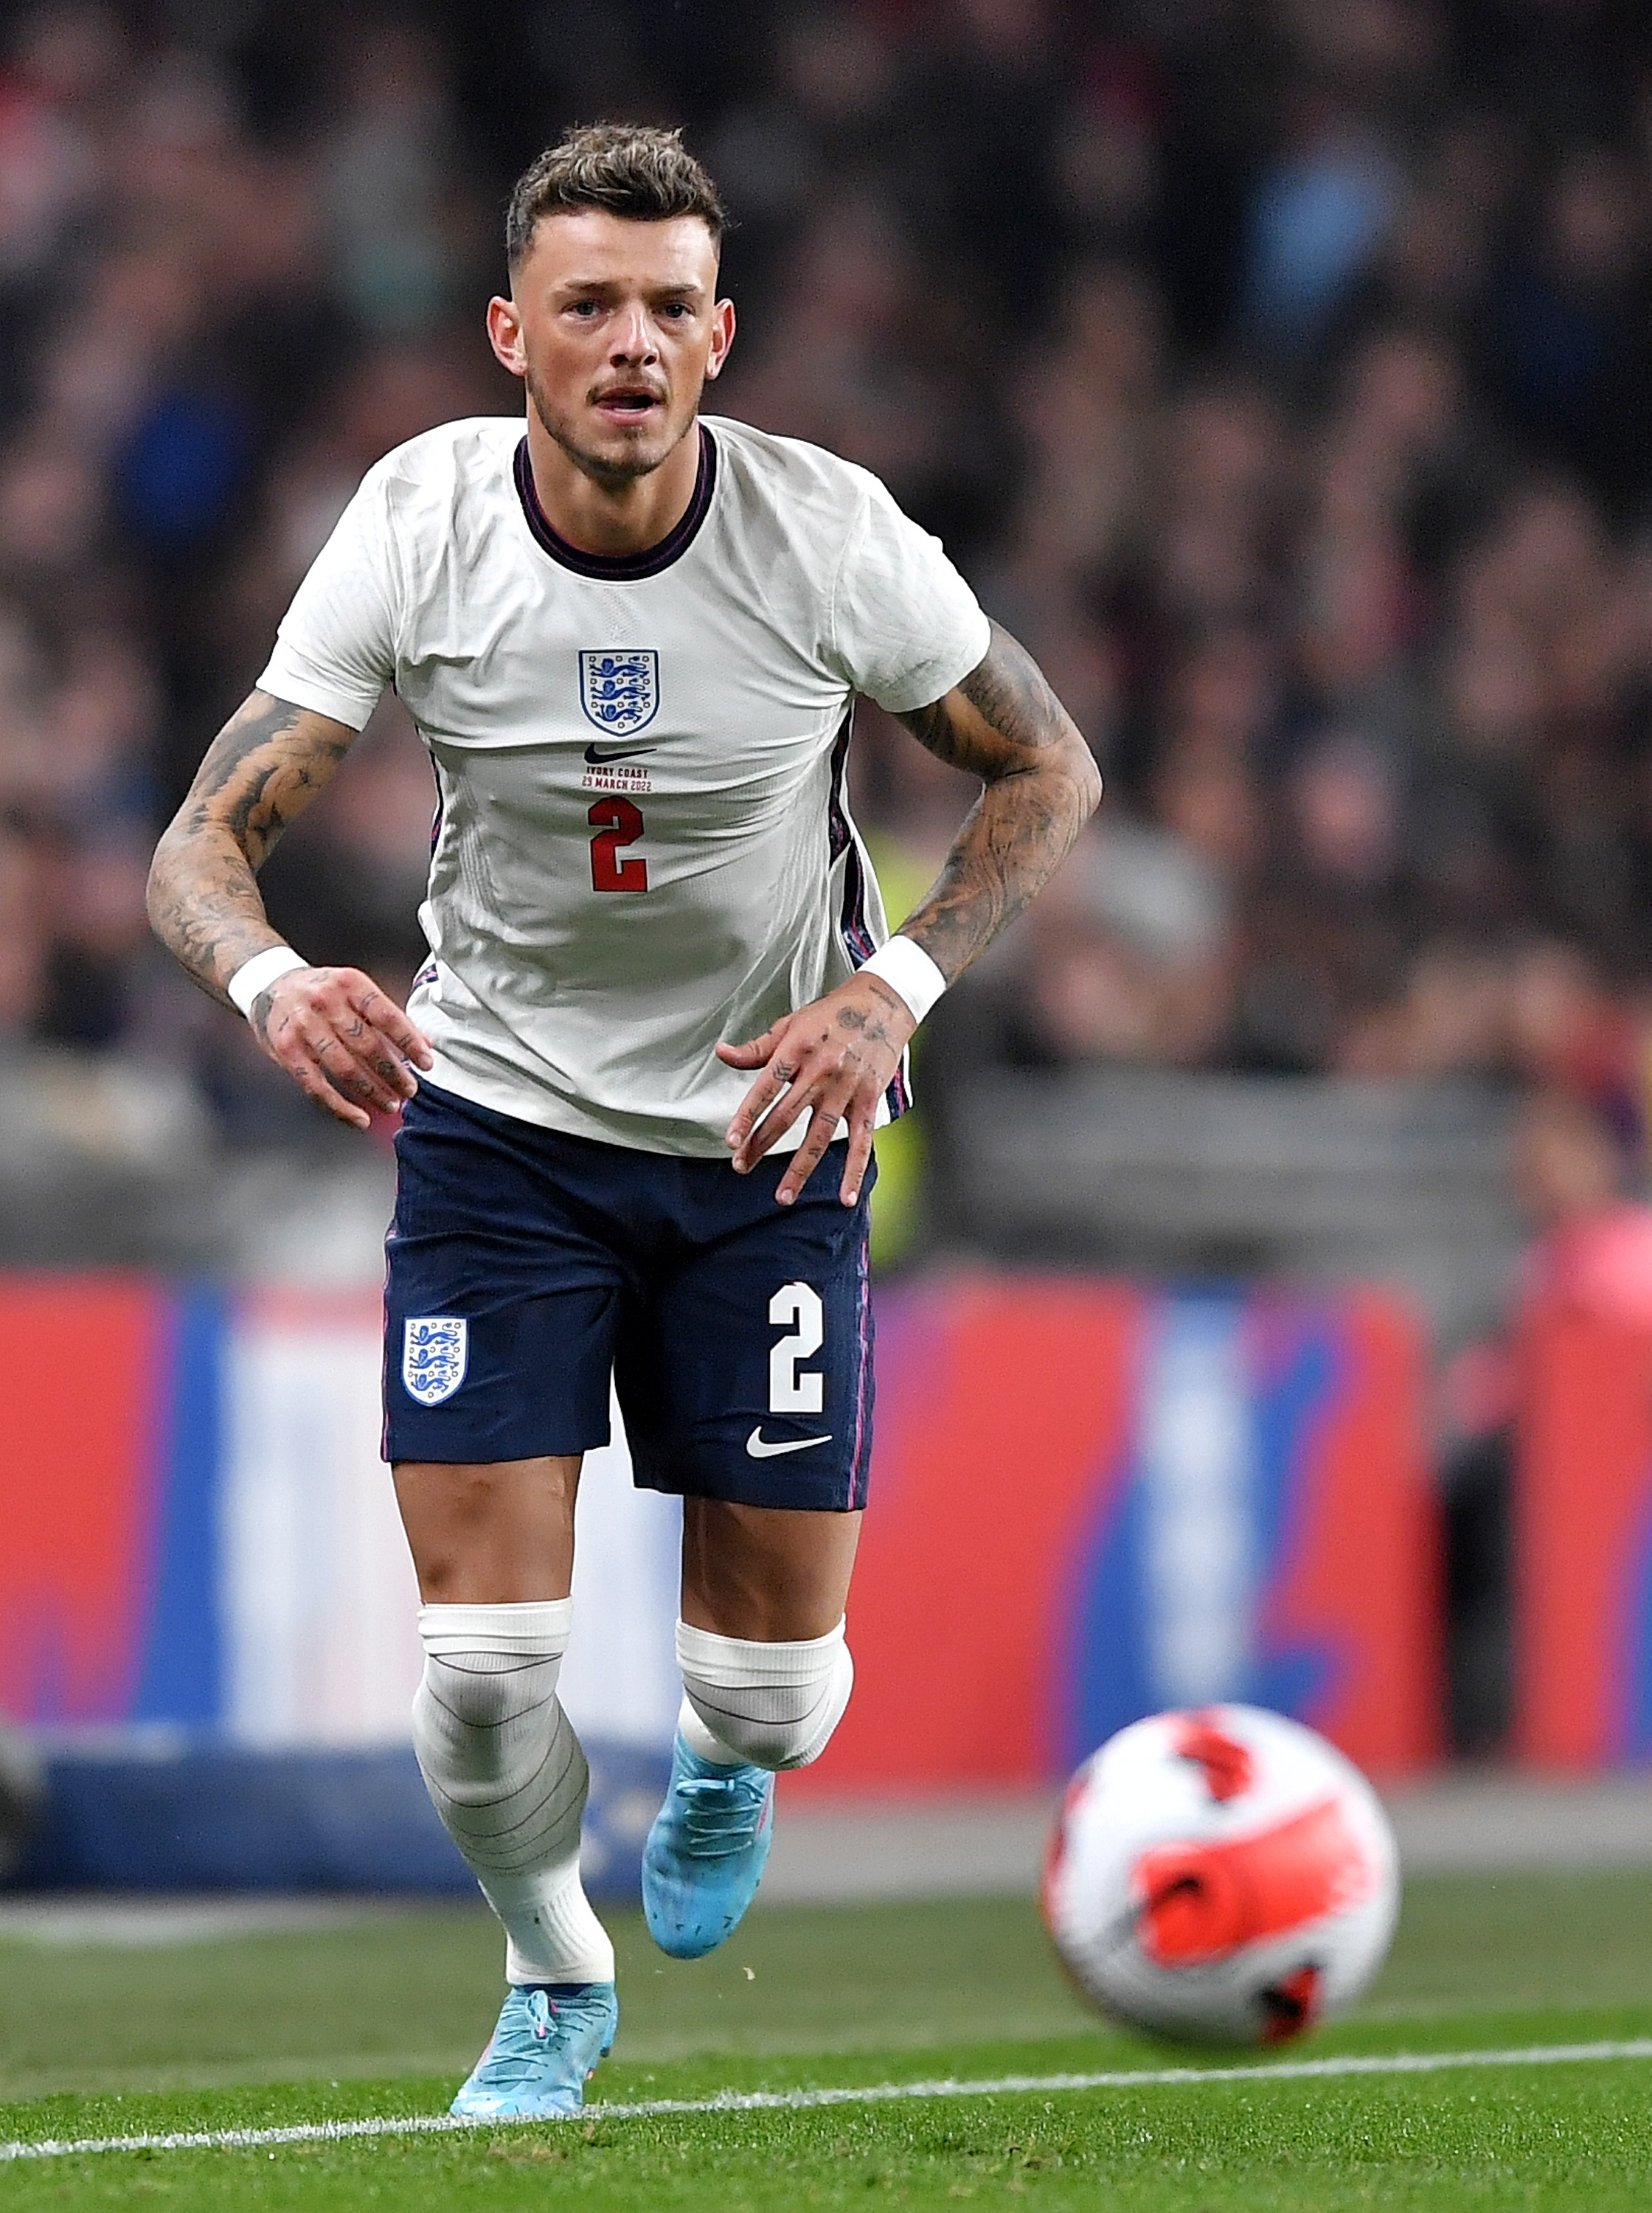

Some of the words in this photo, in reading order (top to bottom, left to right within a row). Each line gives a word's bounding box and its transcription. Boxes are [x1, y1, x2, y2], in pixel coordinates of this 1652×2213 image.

[582, 775, 592, 786] 29
[595, 777, 628, 789] MARCH
[631, 780, 651, 792] 2022
[586, 766, 614, 776] IVORY
[618, 768, 648, 778] COAST
[588, 795, 648, 892] 2
[769, 1281, 823, 1413] 2
